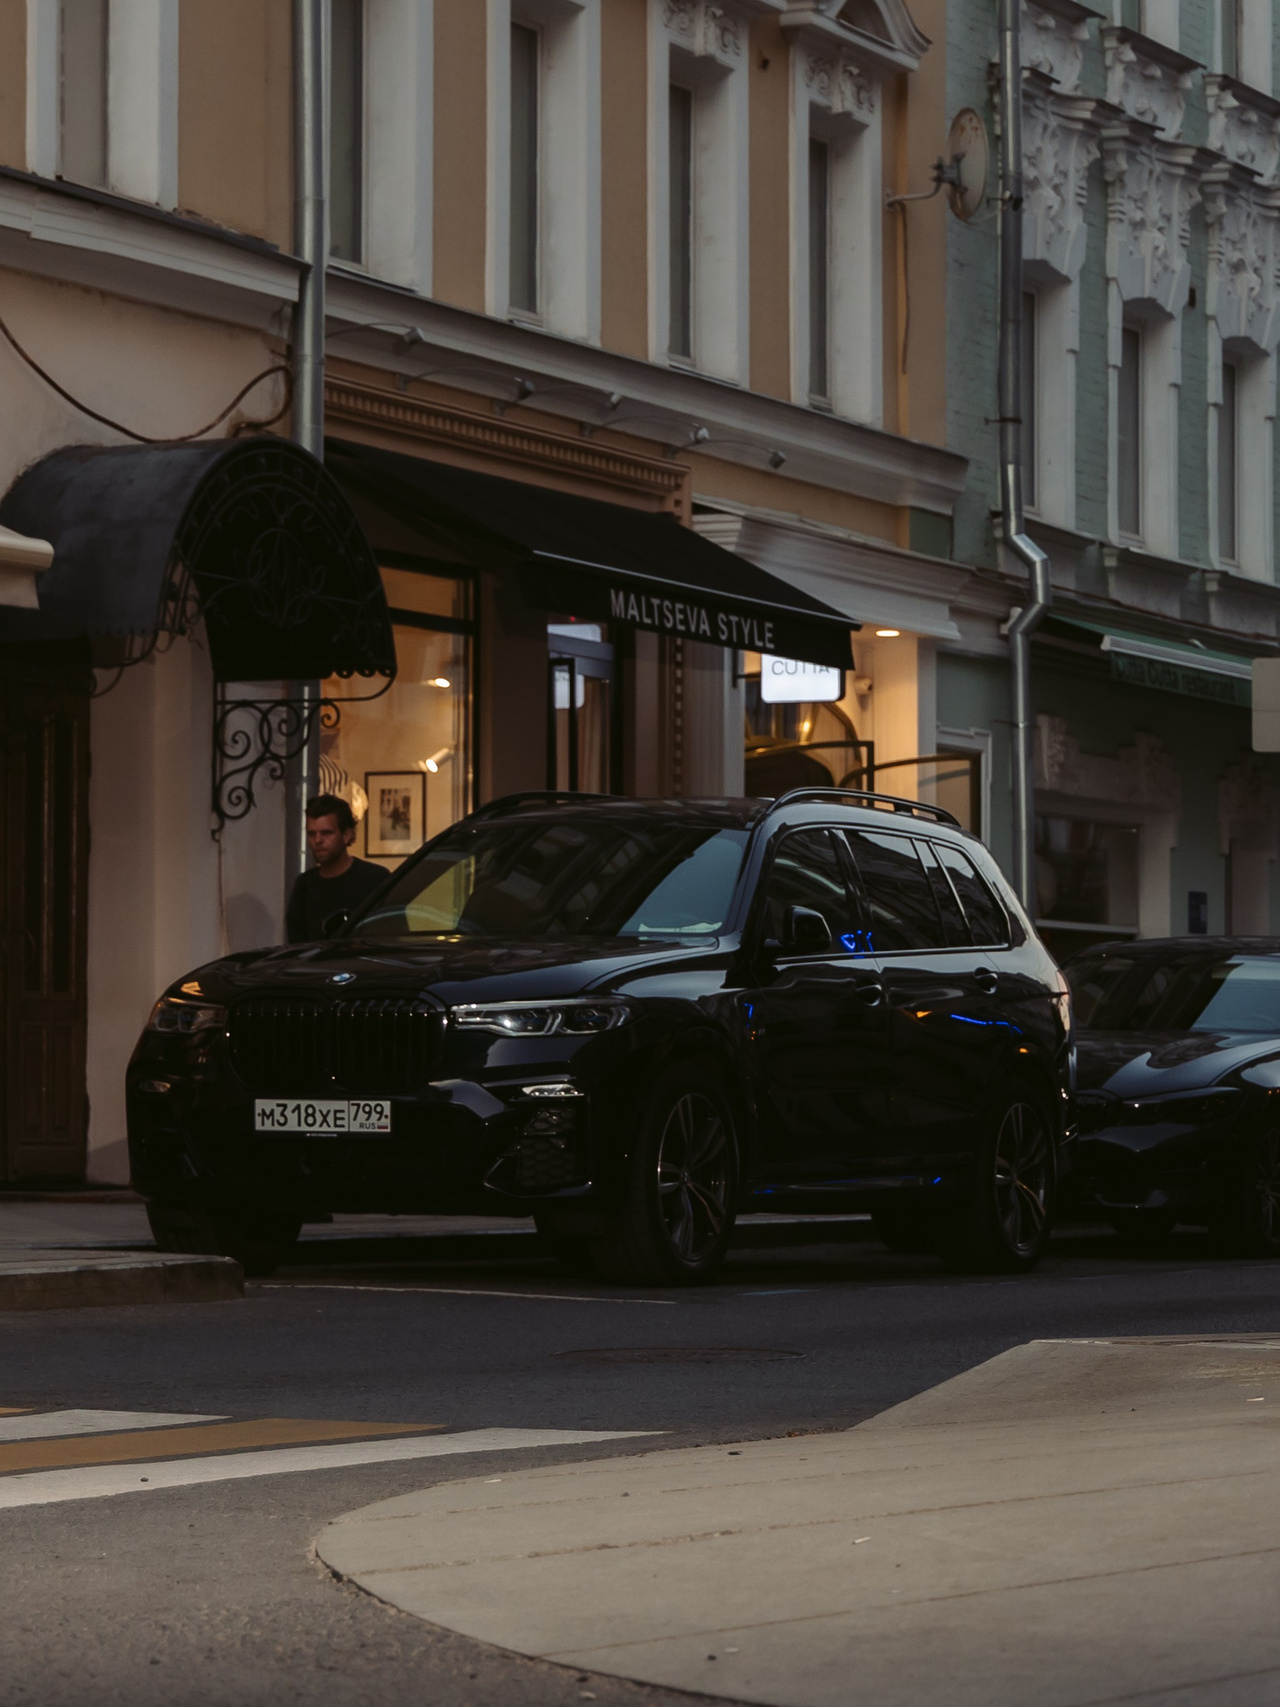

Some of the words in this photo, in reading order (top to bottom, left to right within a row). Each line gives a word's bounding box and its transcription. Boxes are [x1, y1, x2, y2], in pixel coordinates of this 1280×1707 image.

[610, 588, 712, 637] MALTSEVA
[717, 612, 775, 649] STYLE
[351, 1103, 385, 1121] 799
[359, 1122, 376, 1130] RUS
